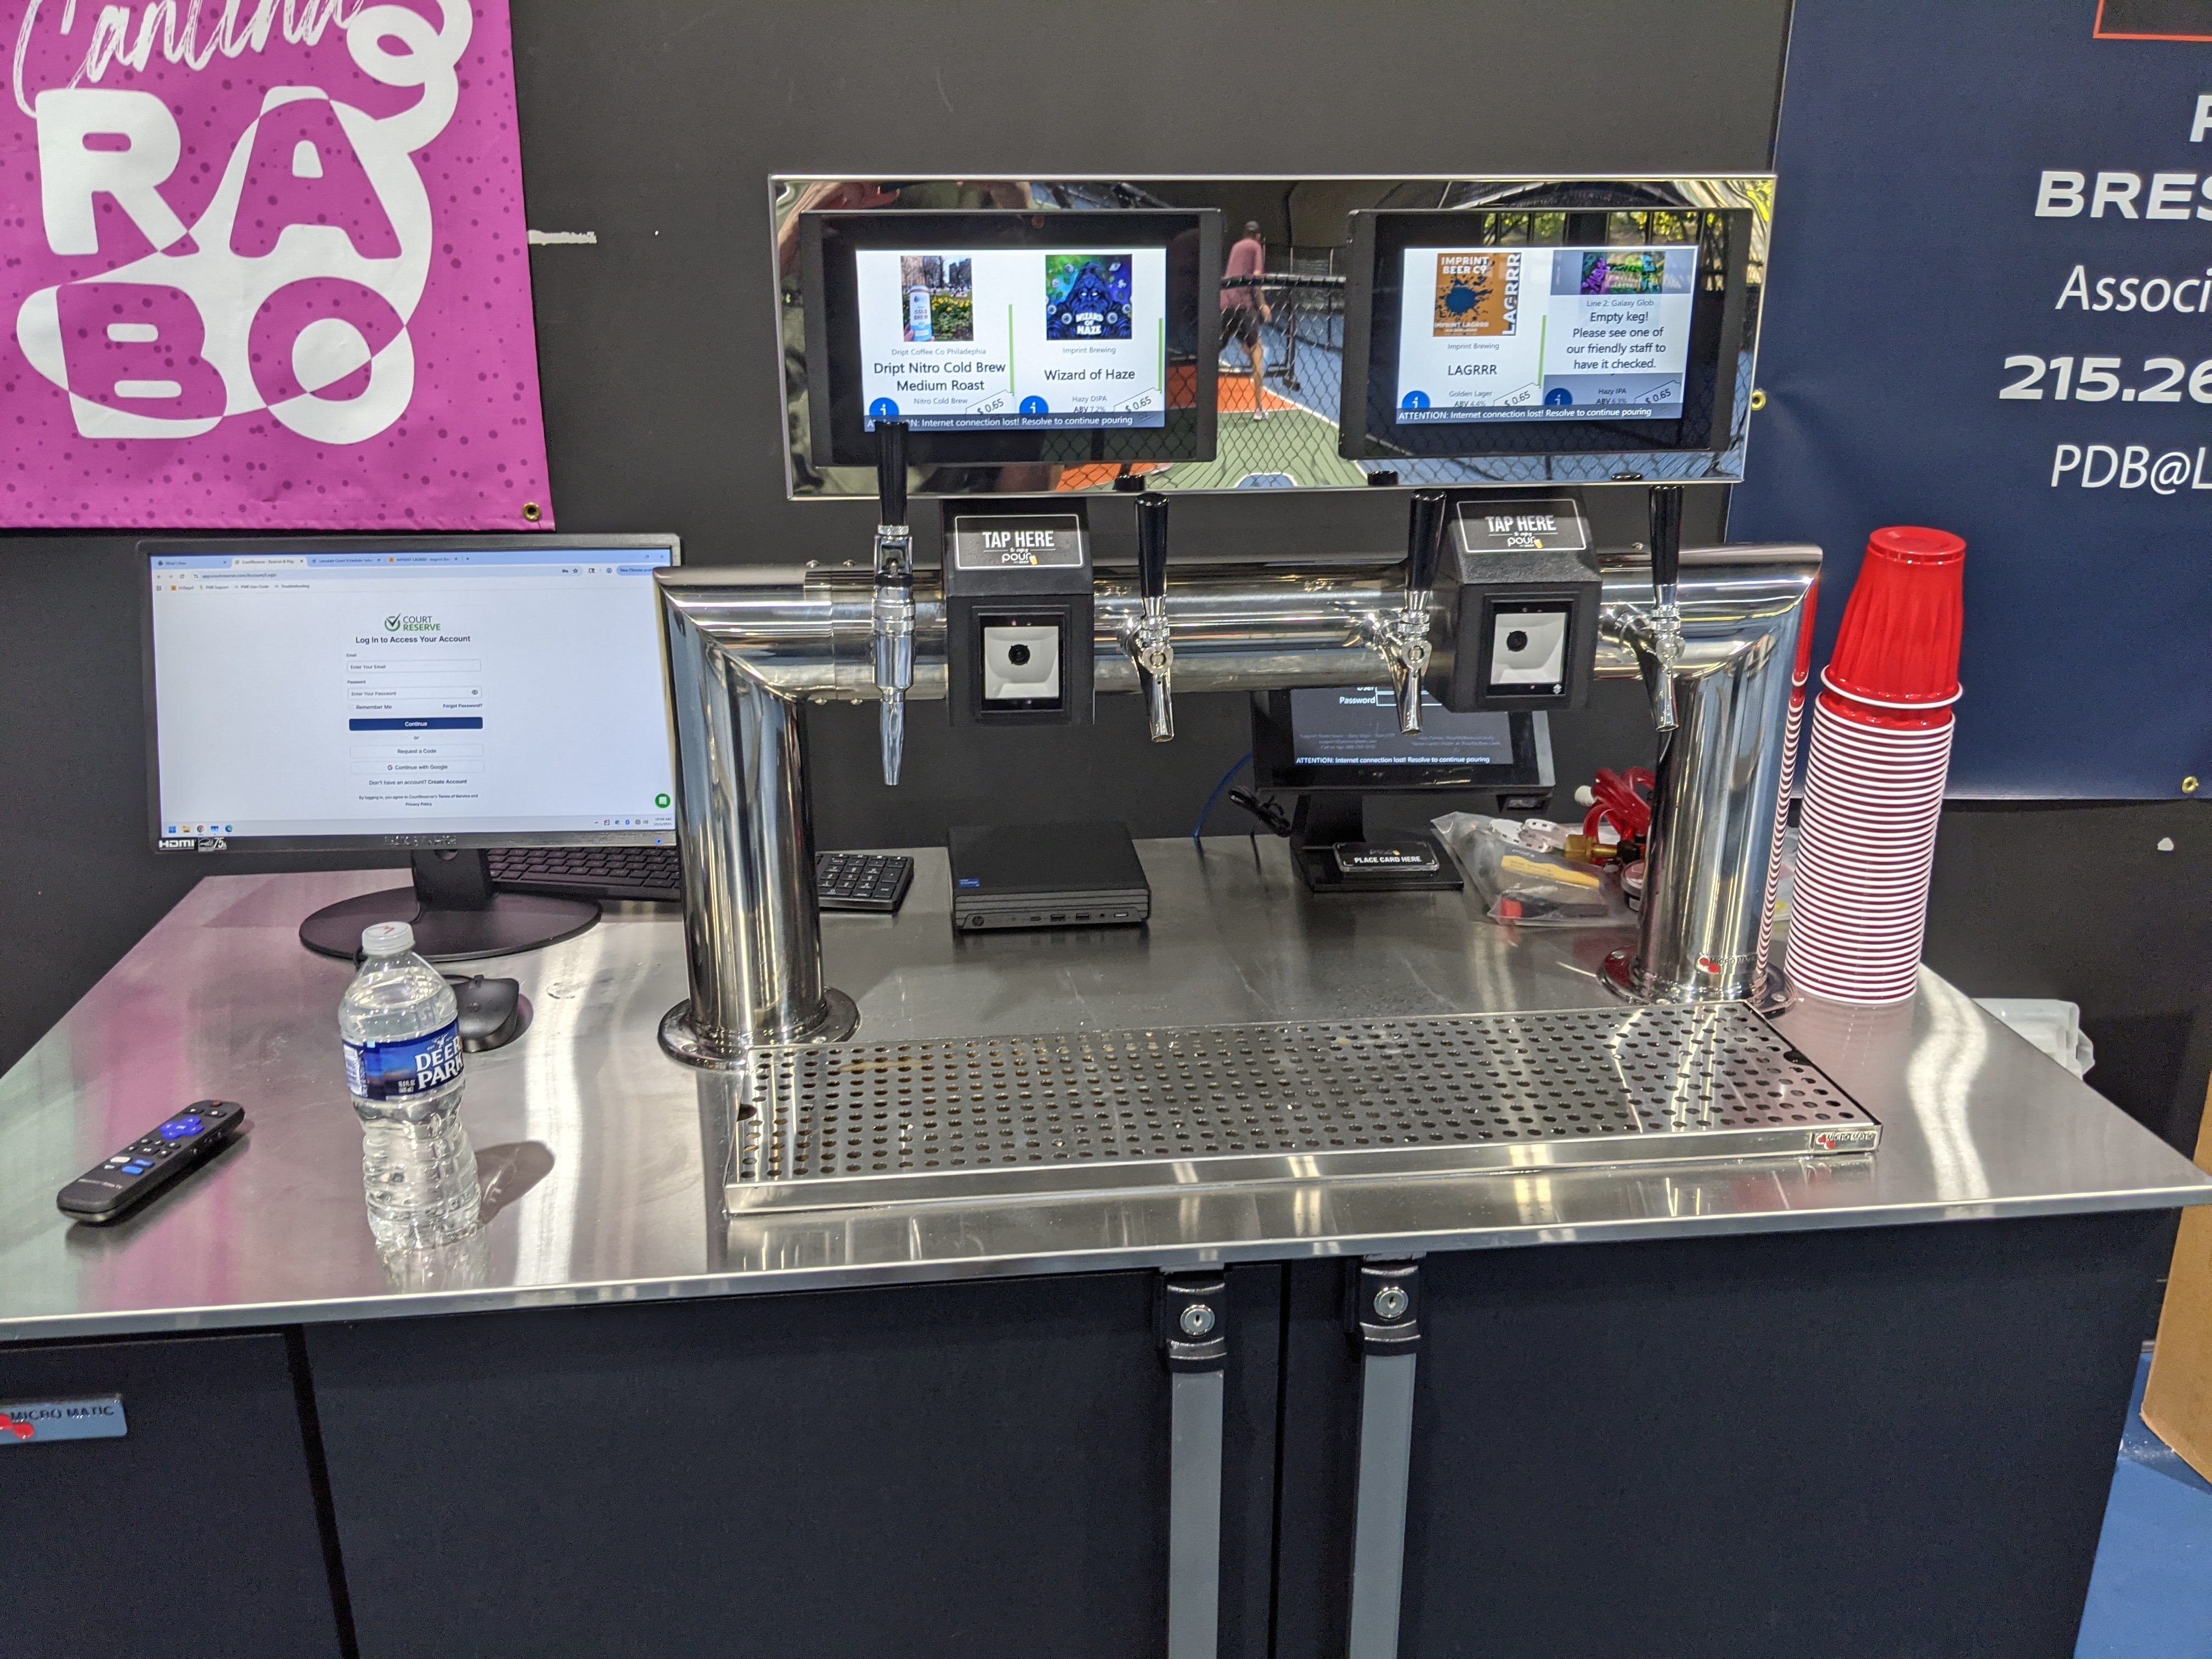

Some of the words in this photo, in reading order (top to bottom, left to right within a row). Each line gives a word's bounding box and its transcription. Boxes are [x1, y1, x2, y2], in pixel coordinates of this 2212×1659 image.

[2035, 171, 2212, 219] BRE
[1441, 256, 1489, 265] IMPRINT
[1443, 266, 1470, 274] BEER
[1502, 254, 1520, 335] LAGRRR
[1076, 312, 1104, 323] WIZARD
[1590, 312, 1624, 324] Empty
[1627, 311, 1649, 324] keg!
[1076, 325, 1102, 335] HAZE
[1573, 328, 1606, 338] Please
[1652, 327, 1664, 336] of
[1566, 346, 1585, 354] our
[1588, 343, 1628, 356] friendly
[1629, 343, 1653, 352] staff
[874, 363, 905, 376] Dript
[909, 363, 940, 374] Nitro
[944, 362, 972, 373] Cold
[977, 362, 1006, 373] Brew
[1573, 360, 1598, 370] have
[1601, 359, 1609, 369] it
[1612, 358, 1656, 369] checked.
[1044, 370, 1086, 380] Wizard
[1090, 369, 1103, 380] of
[1106, 369, 1136, 379] Haze
[1448, 364, 1498, 376] LAGRRR
[897, 380, 947, 391] Medium
[952, 380, 985, 391] Roast
[1483, 410, 1526, 419] connection
[1622, 408, 1652, 417] pouring
[955, 419, 1001, 427] connection
[1102, 417, 1133, 426] pouring
[1485, 516, 1514, 532] TAP
[1516, 515, 1556, 531] HERE
[982, 531, 1011, 548] TAP
[1015, 531, 1054, 547] HERE
[1507, 537, 1536, 548] pour
[1002, 552, 1031, 563] pour
[356, 636, 369, 645] Log
[1340, 696, 1375, 704] Password
[159, 840, 195, 848] HDMI
[10, 1409, 61, 1420] MICRO
[66, 1406, 114, 1417] MATIC
